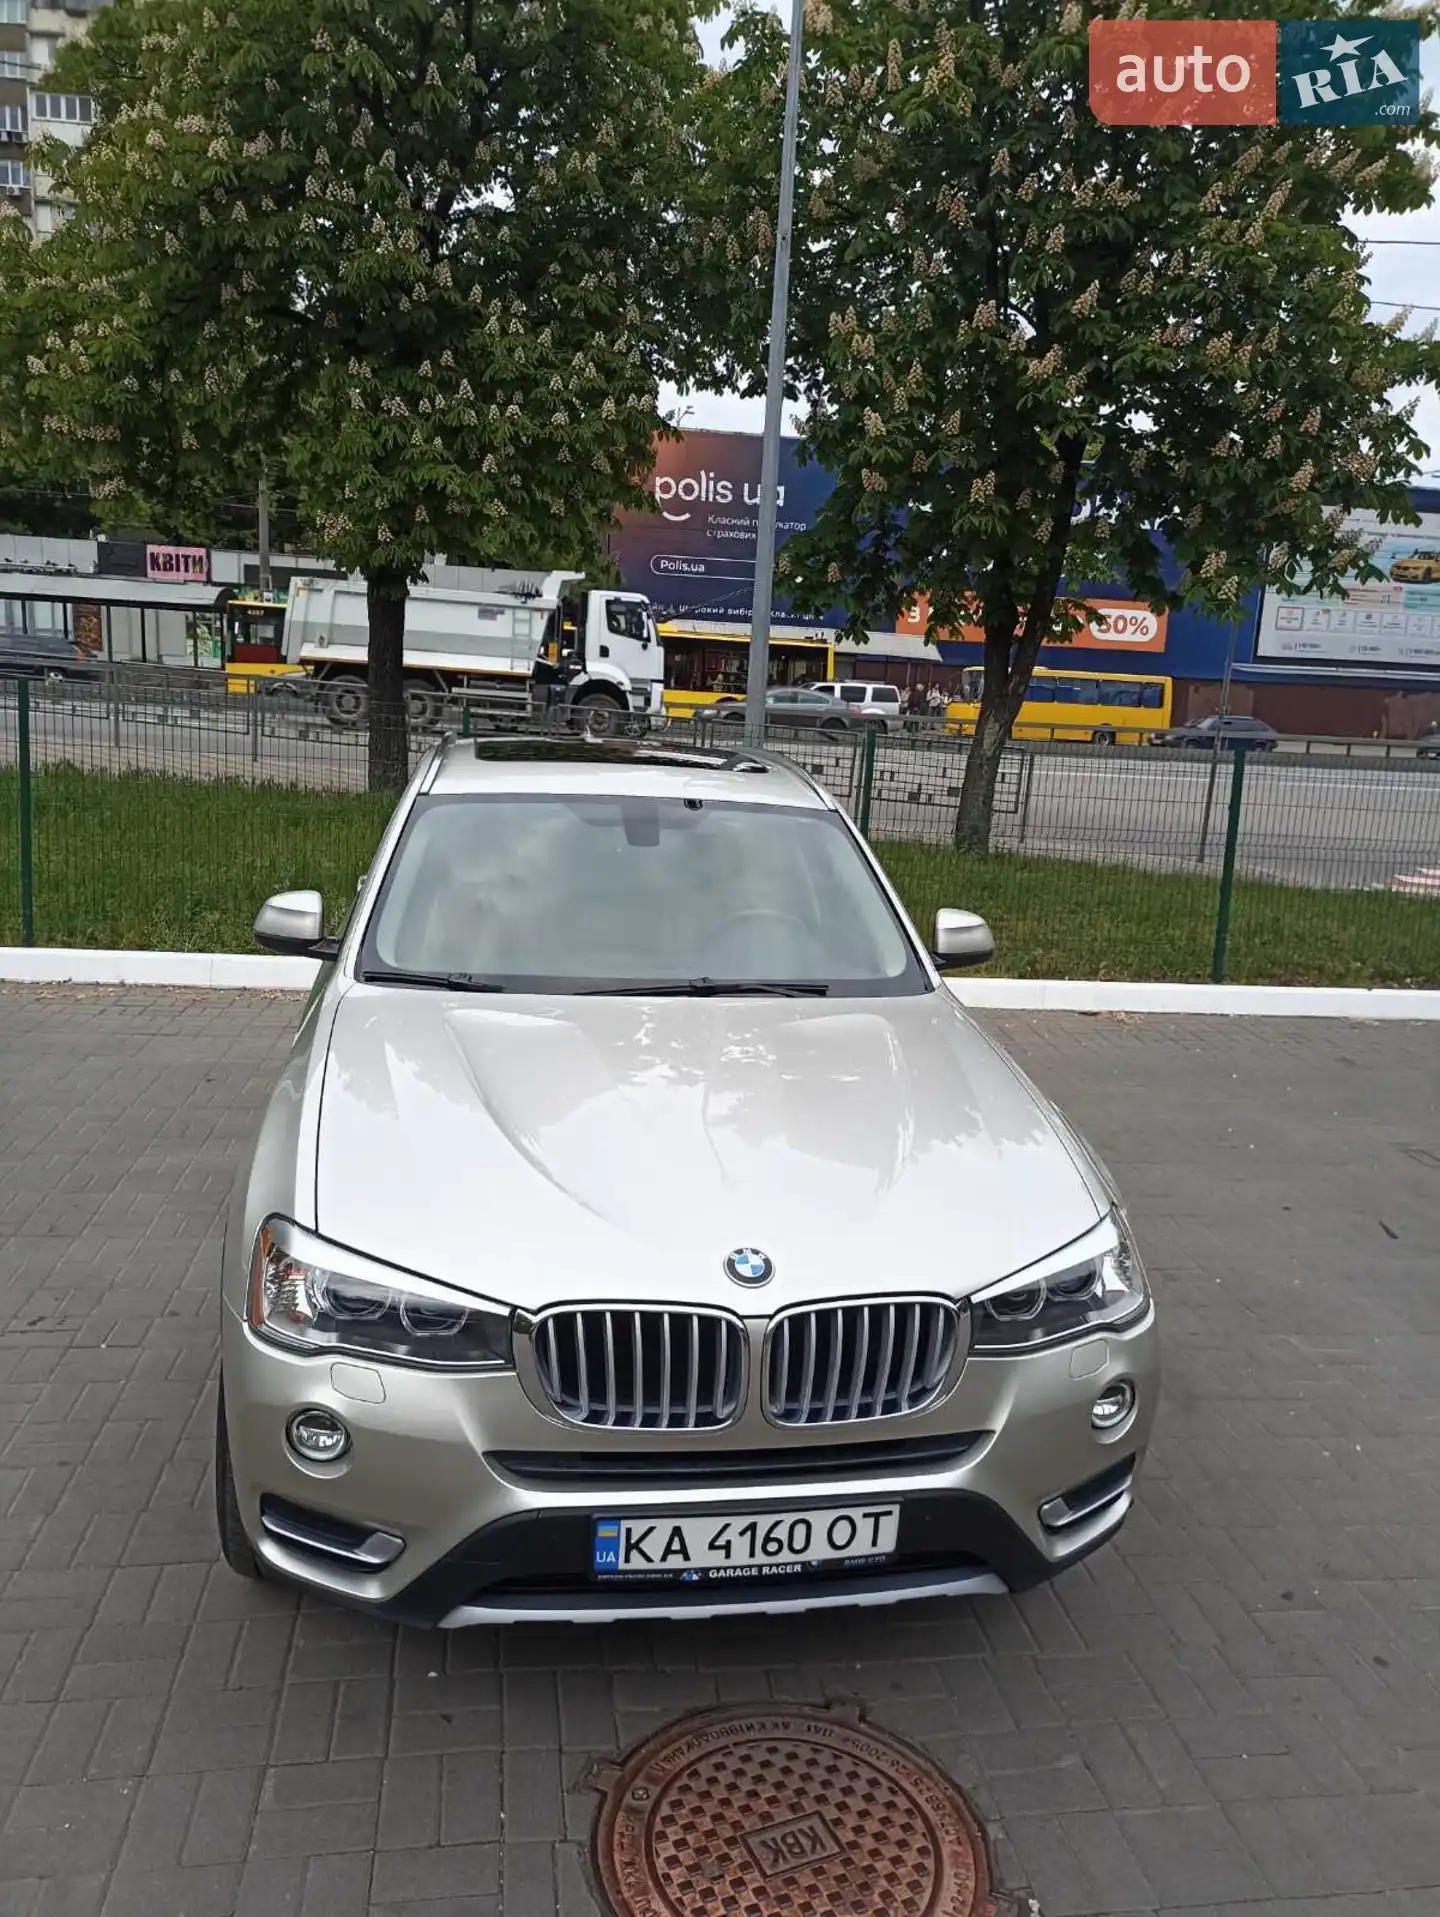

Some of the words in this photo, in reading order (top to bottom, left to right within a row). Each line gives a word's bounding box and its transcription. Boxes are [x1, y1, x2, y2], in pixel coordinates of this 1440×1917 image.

[654, 470, 733, 508] polis
[707, 514, 750, 526] Класний
[752, 519, 807, 532] пкатор
[706, 529, 756, 540] страхових
[660, 559, 705, 573] Polis.ua
[1097, 614, 1149, 636] 50%
[623, 1525, 692, 1565] KA
[708, 1517, 813, 1560] 4160
[826, 1510, 894, 1552] OT
[596, 1551, 617, 1563] UA
[708, 1566, 759, 1580] GARAGE
[761, 1563, 802, 1576] RACER
